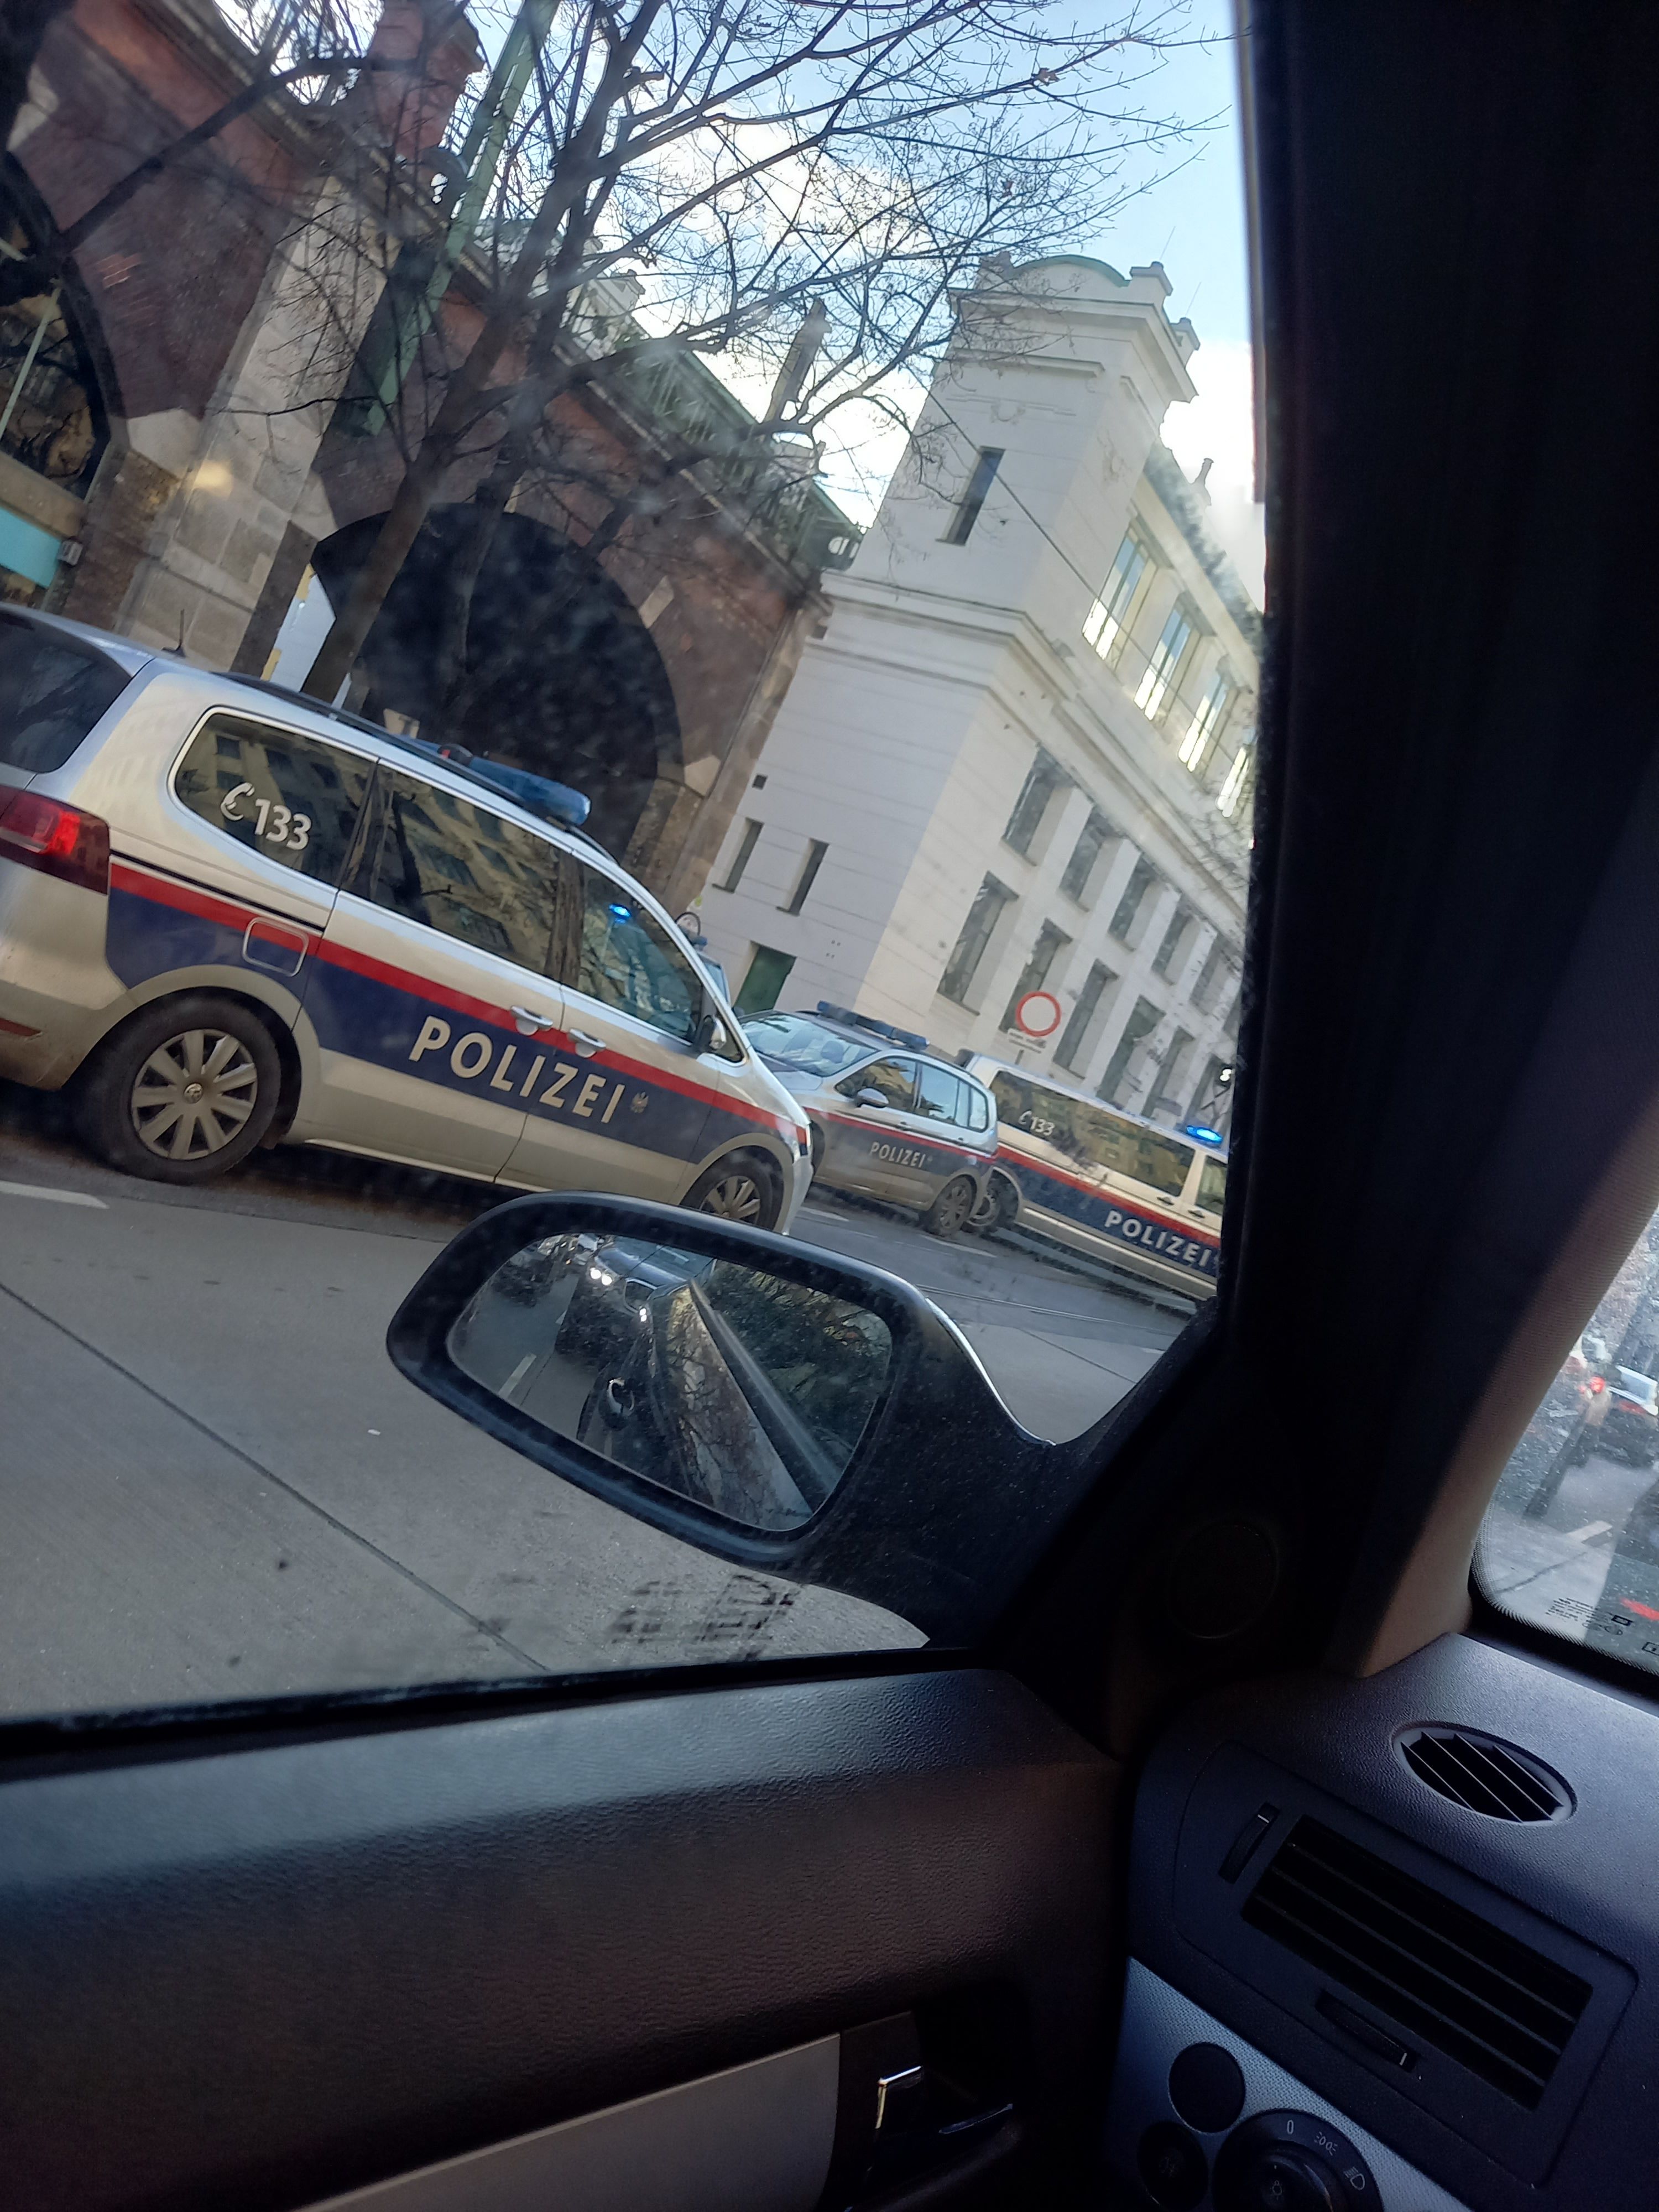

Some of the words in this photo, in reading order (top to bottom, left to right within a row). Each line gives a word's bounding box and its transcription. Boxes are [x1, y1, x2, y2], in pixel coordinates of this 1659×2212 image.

[254, 799, 311, 850] 133
[408, 1015, 625, 1124] POLIZEI
[1030, 1117, 1055, 1136] 133
[869, 1141, 927, 1168] POLIZEI
[1104, 1209, 1212, 1267] POLIZEI
